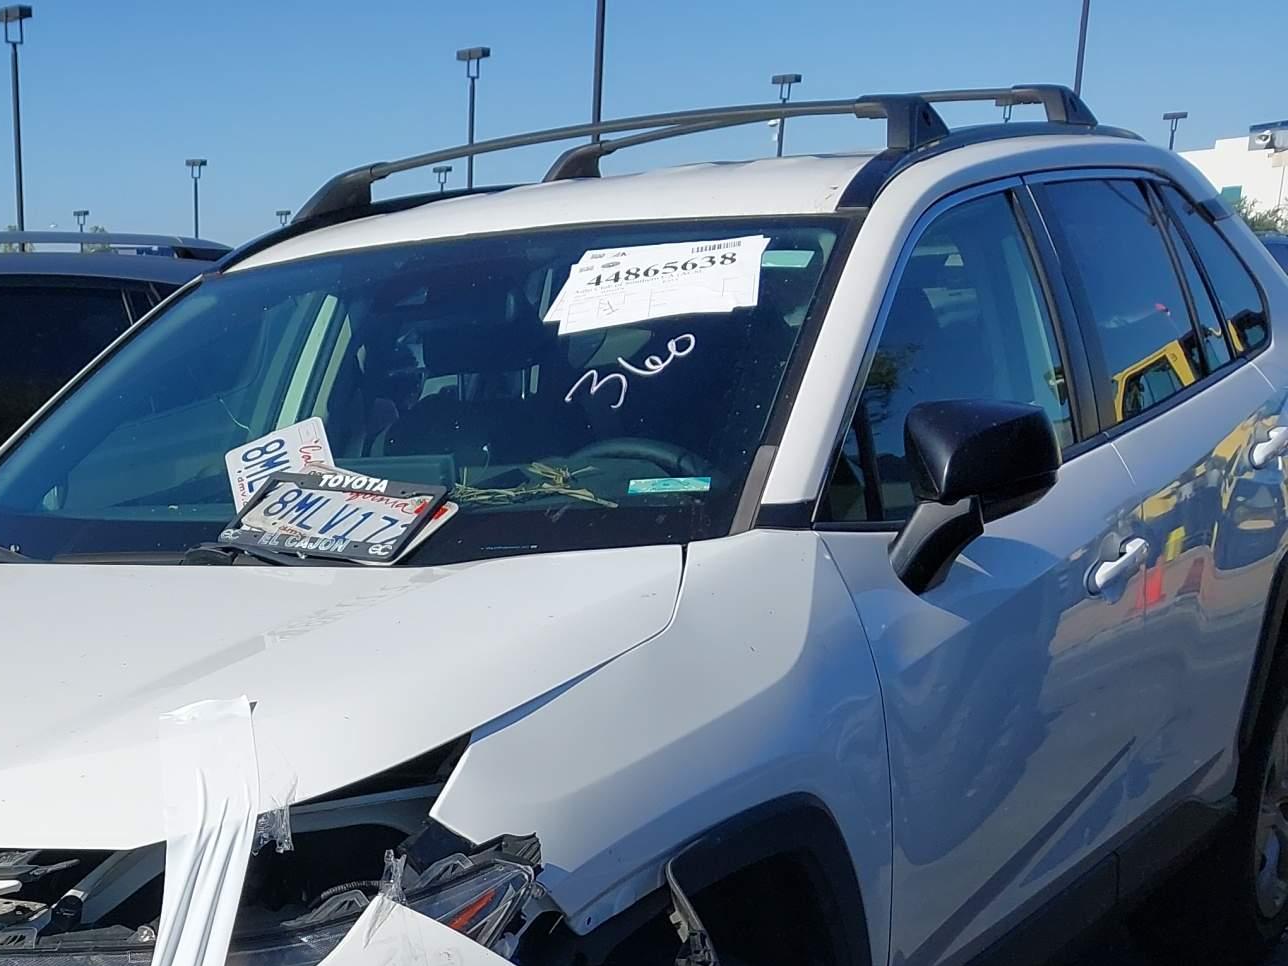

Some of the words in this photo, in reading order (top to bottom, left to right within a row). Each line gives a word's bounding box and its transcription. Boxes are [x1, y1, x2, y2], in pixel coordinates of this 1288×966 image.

[586, 252, 737, 286] 44865638
[564, 333, 695, 409] 360
[318, 473, 389, 494] TOYOTA
[257, 532, 279, 546] EL
[284, 535, 351, 553] CAJON
